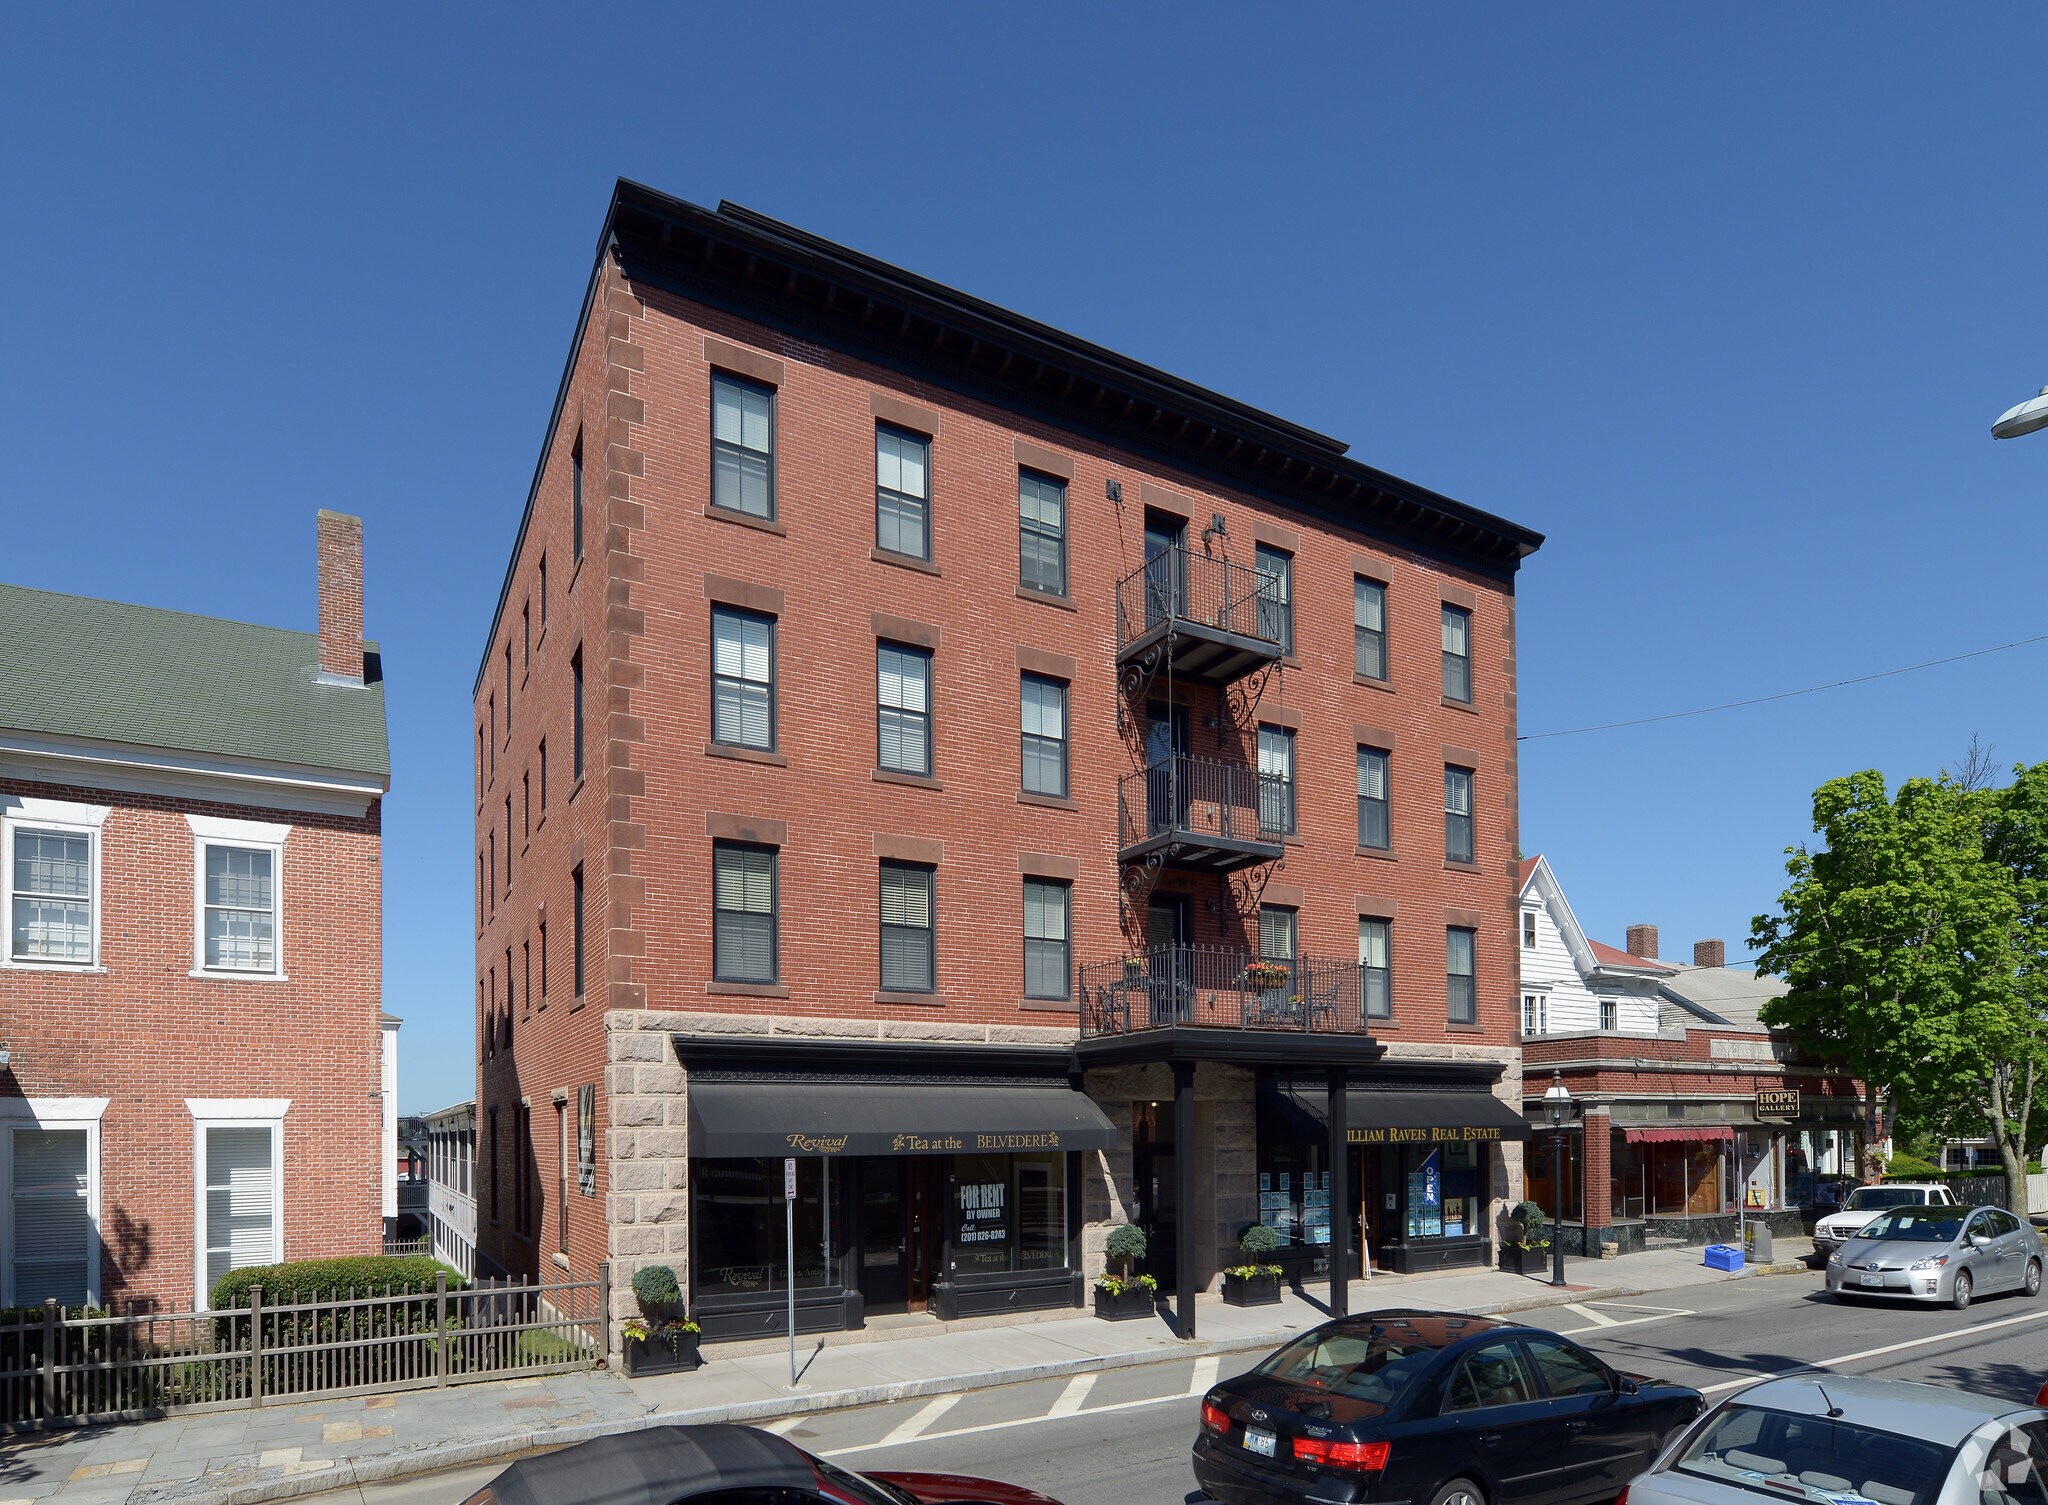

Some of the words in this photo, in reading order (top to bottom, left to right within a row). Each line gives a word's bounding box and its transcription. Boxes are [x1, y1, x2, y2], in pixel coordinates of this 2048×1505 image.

[1759, 1092, 1796, 1104] HOPE
[1759, 1104, 1796, 1112] GALLERY
[906, 1135, 929, 1150] Tea
[931, 1138, 943, 1149] at
[944, 1136, 963, 1149] the
[976, 1134, 1048, 1148] BELVEDERE
[1346, 1129, 1384, 1142] ILLIAM
[1389, 1127, 1427, 1142] RAVEIS
[1432, 1127, 1459, 1141] REAL
[1463, 1126, 1500, 1141] ESTATE
[786, 1134, 849, 1152] Revival
[1426, 1166, 1434, 1201] OPEN
[960, 1185, 979, 1209] FOR
[980, 1183, 1005, 1208] RENT
[966, 1209, 976, 1220] BY
[976, 1208, 1001, 1219] OWNER
[961, 1232, 977, 1242] (201)
[719, 1267, 764, 1286] Revival
